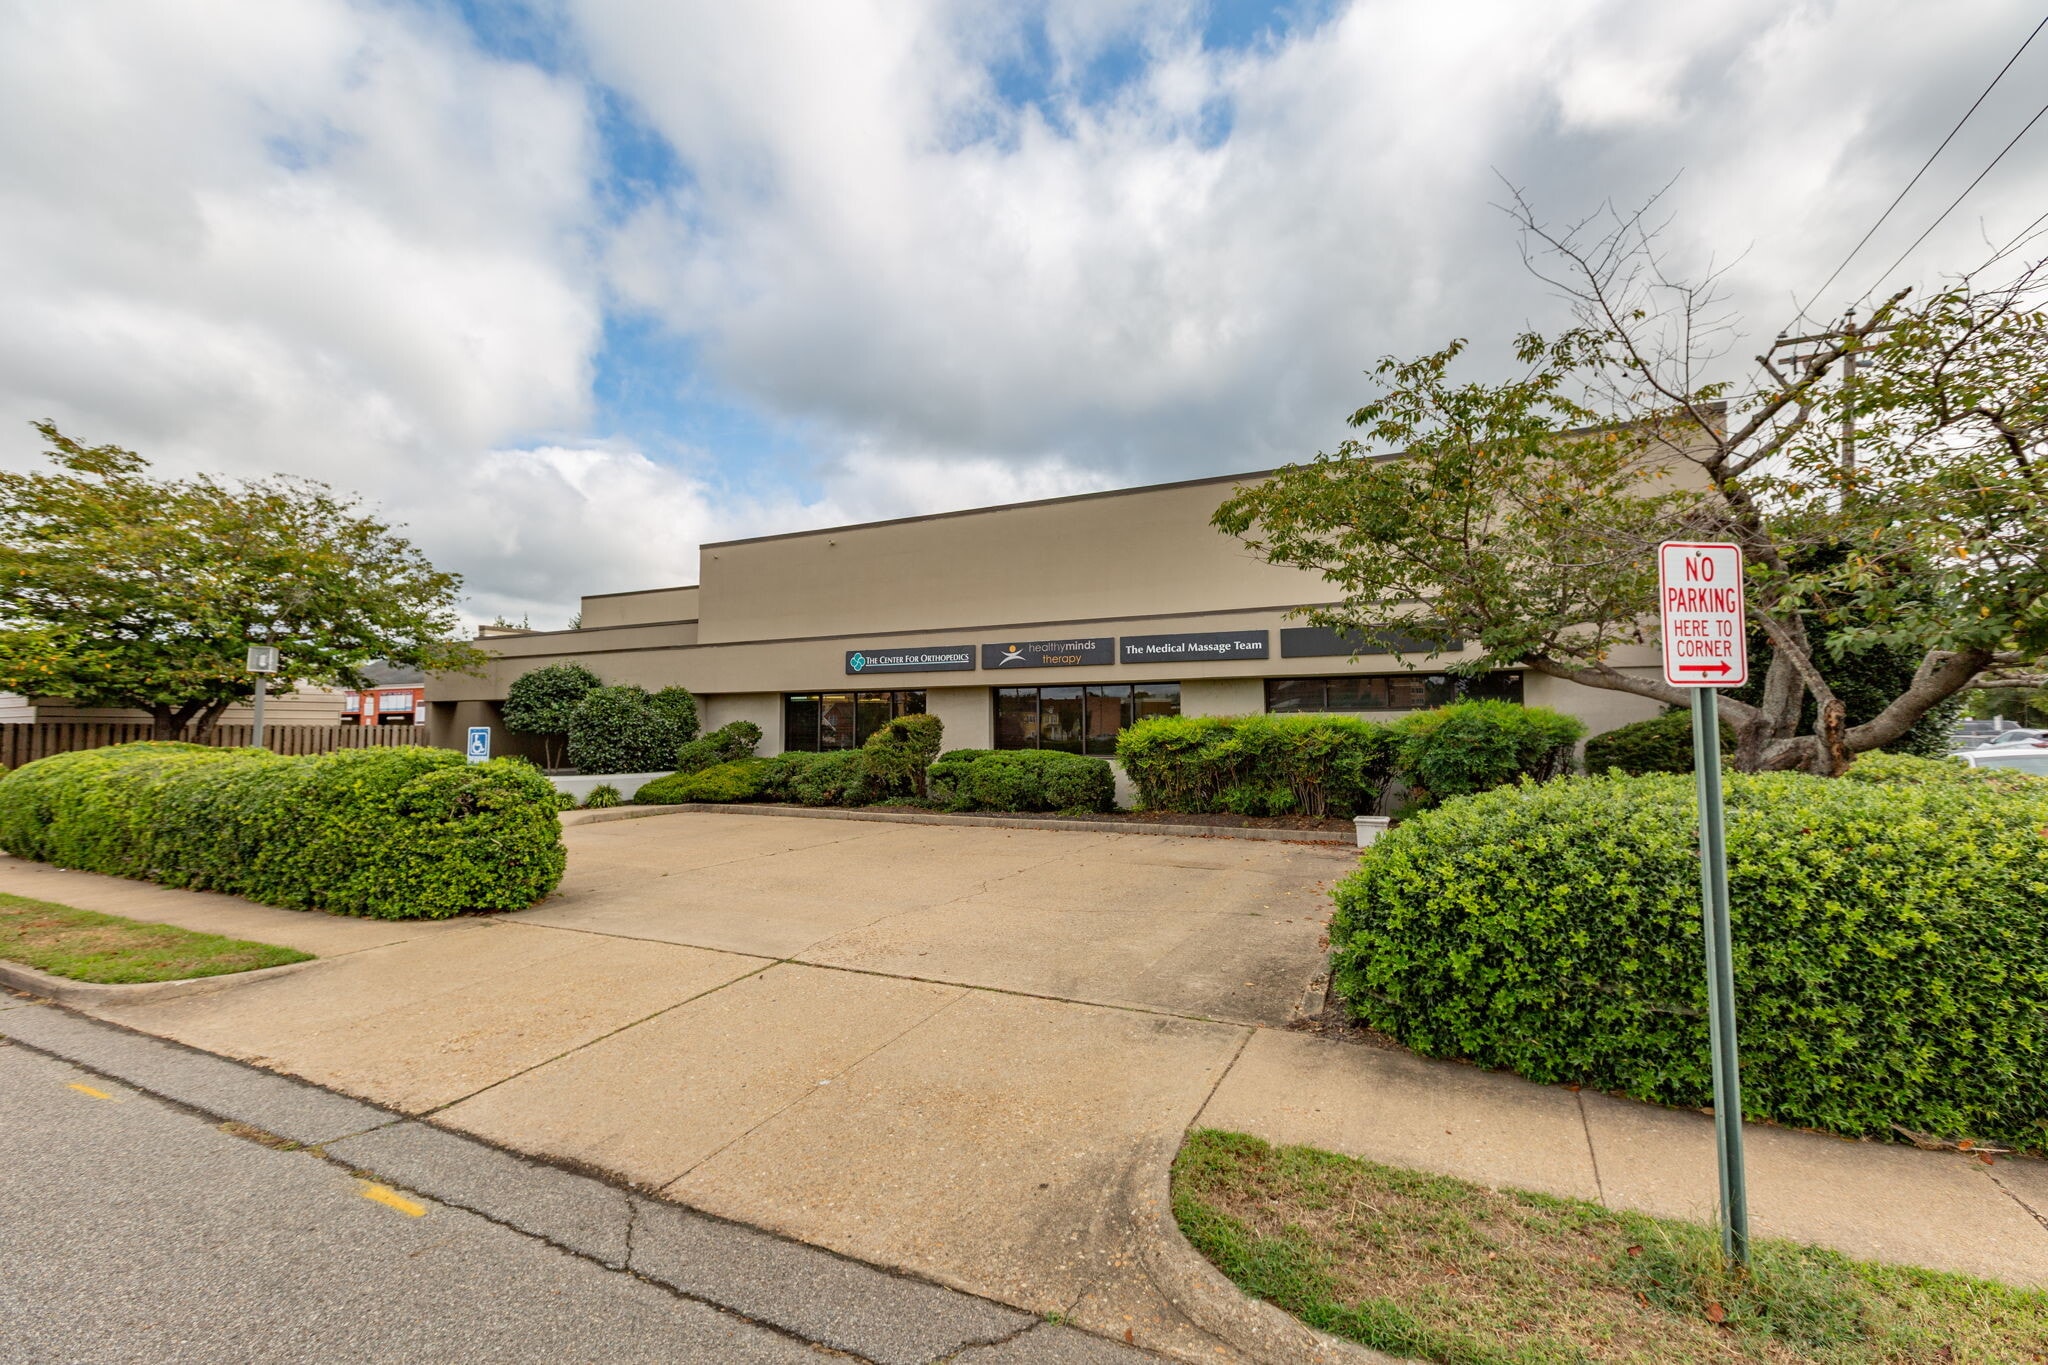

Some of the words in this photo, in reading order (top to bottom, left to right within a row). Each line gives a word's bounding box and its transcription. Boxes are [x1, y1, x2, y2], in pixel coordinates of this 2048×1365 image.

[1686, 557, 1714, 582] NO
[1668, 587, 1736, 613] PARKING
[1674, 620, 1709, 637] HERE
[1716, 620, 1732, 637] TO
[1028, 640, 1096, 653] healthyminds
[1126, 645, 1143, 654] The
[1146, 643, 1185, 654] Medical
[1188, 642, 1231, 653] Massage
[1234, 641, 1262, 650] Team
[1677, 640, 1732, 657] CORNER
[866, 656, 878, 664] THE
[880, 655, 904, 664] CENTER
[905, 654, 919, 663] FOR
[920, 653, 970, 663] ORTHOPEDICS
[1042, 654, 1082, 664] therapy
